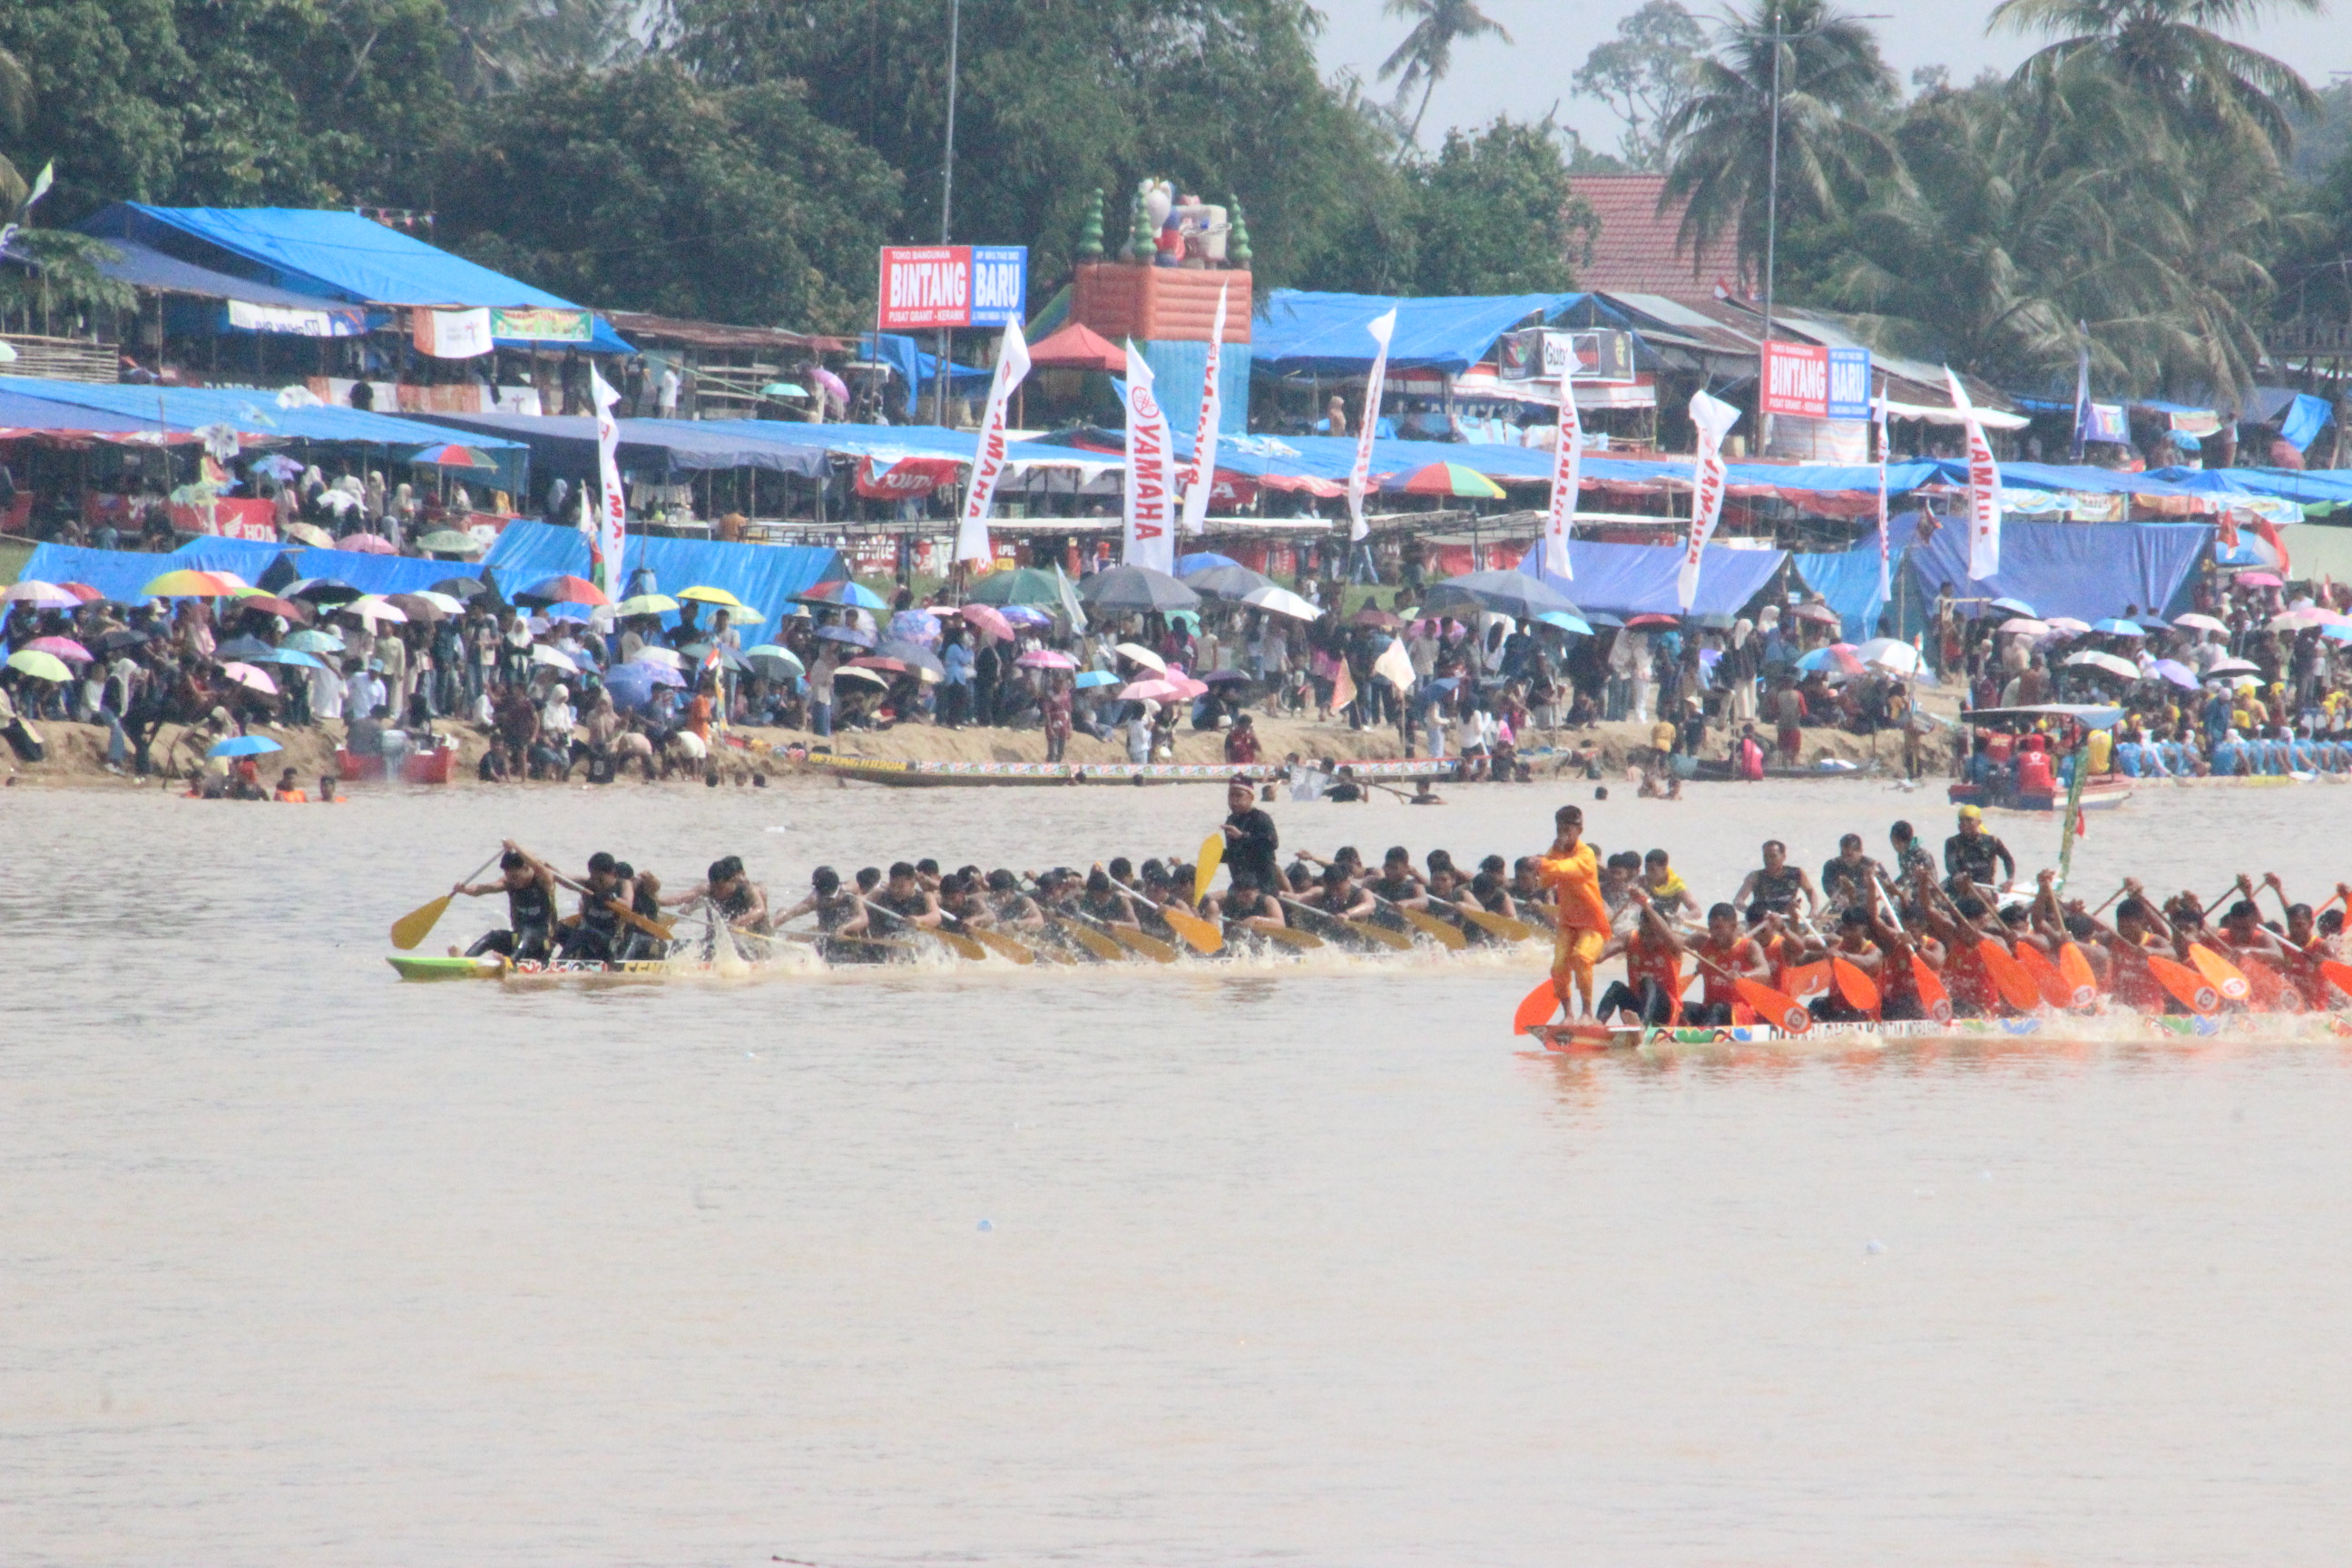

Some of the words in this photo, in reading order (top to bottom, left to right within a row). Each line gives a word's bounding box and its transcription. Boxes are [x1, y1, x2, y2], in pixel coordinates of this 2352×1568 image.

[889, 261, 966, 308] BINTANG
[975, 262, 1021, 309] BARU
[1769, 354, 1826, 401] BINTANG
[1831, 361, 1866, 403] BARU
[968, 399, 1005, 518] AMAHA
[1133, 424, 1164, 541] YAMAHA
